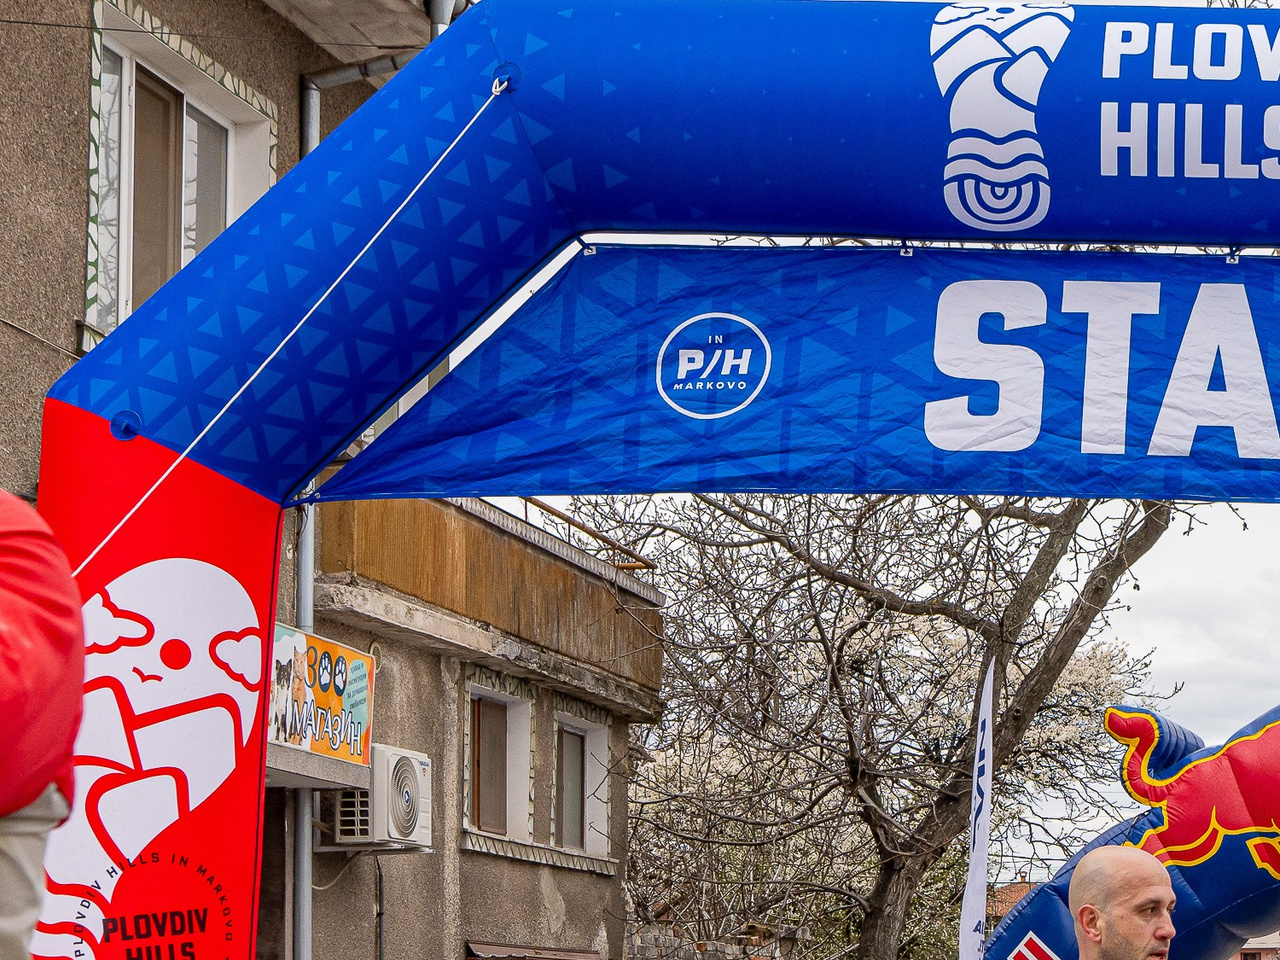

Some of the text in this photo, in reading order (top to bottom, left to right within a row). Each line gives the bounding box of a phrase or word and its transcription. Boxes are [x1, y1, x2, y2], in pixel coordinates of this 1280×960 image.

[708, 335, 723, 344] IN
[677, 348, 752, 379] P/H
[673, 381, 747, 390] MARKOVO
[291, 700, 362, 756] МАГАЗИН
[73, 852, 234, 957] PLOVDIV HILLS IN MARKOVO
[102, 908, 209, 943] PLOVDIV
